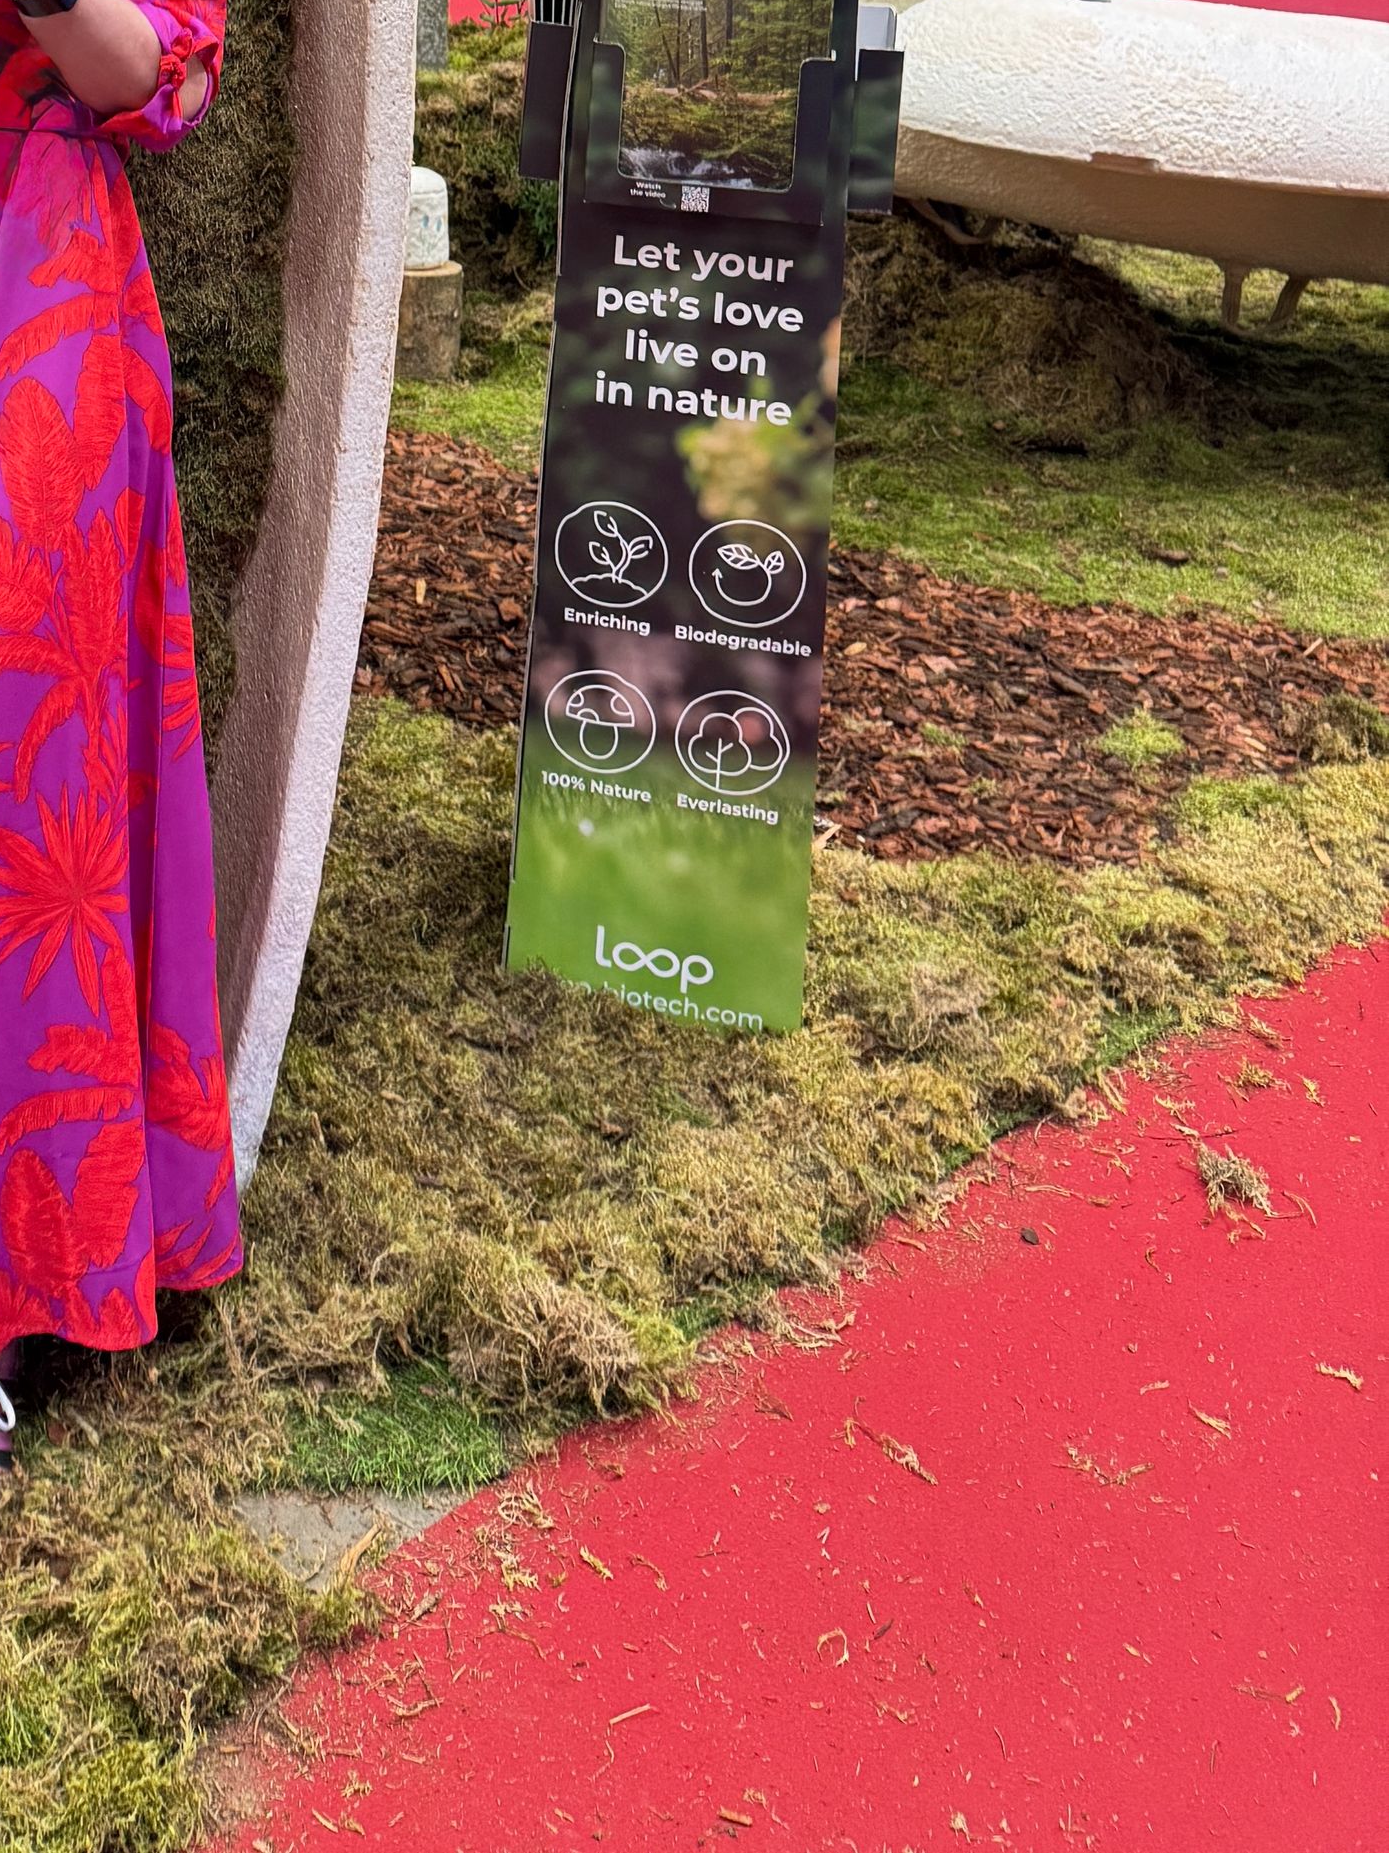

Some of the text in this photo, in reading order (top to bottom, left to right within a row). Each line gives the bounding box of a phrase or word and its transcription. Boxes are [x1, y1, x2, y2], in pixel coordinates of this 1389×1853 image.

[630, 189, 666, 199] the video
[635, 181, 661, 190] Watch
[614, 235, 794, 283] Let your
[597, 286, 803, 333] pet's love
[624, 330, 766, 376] live on
[595, 371, 792, 426] in nature
[564, 607, 651, 637] Enriching
[674, 624, 812, 657] Biodegradable
[541, 770, 652, 803] 100% Nature
[676, 793, 779, 825] Everlasting
